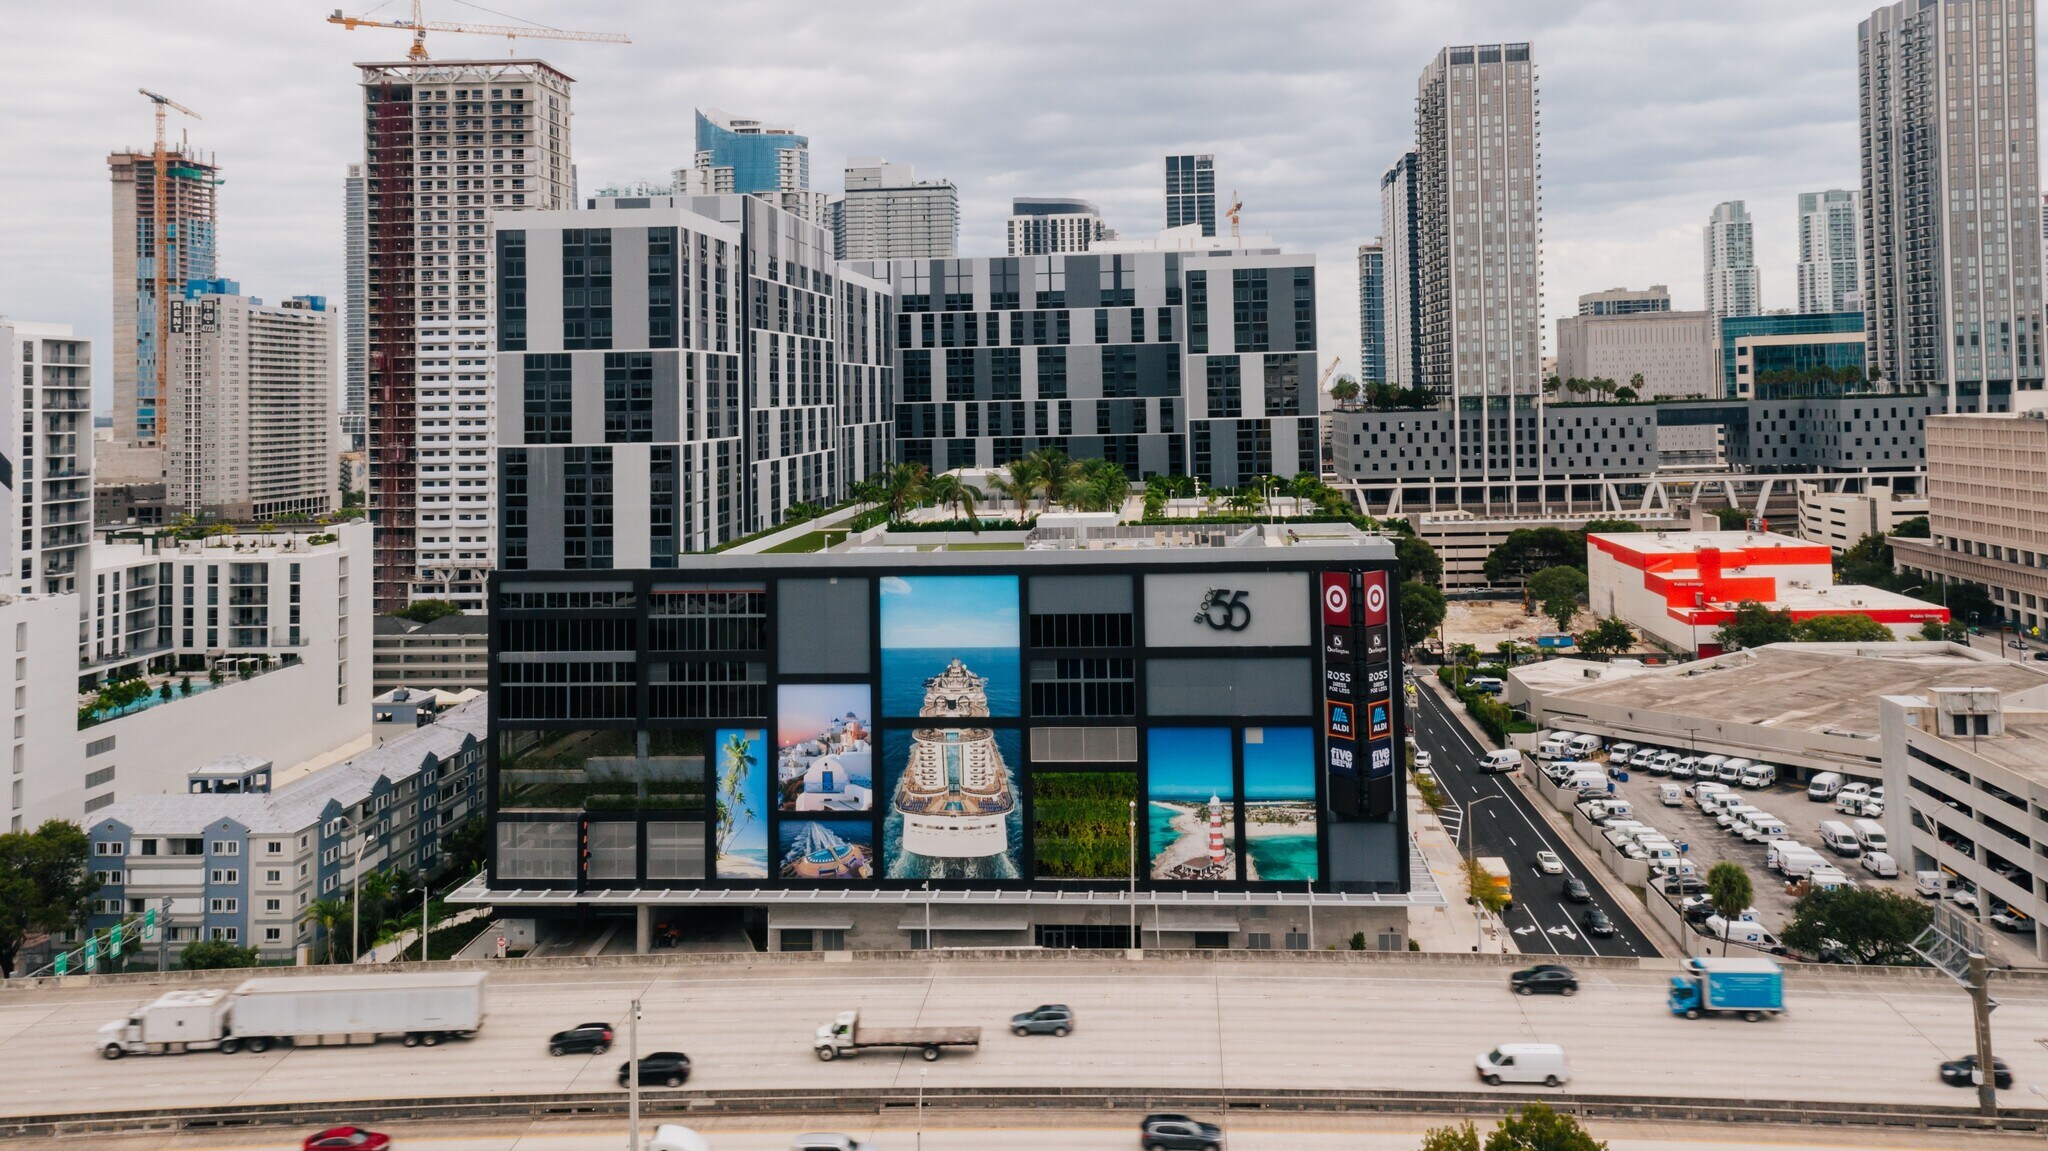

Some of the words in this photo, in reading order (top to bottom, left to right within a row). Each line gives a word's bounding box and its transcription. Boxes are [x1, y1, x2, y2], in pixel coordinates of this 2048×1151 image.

[173, 302, 182, 332] RENT
[1193, 586, 1217, 624] BLOCK
[1205, 588, 1251, 632] 55
[1326, 645, 1350, 655] Burlington
[1327, 670, 1351, 683] ROSS
[1368, 670, 1388, 682] ROSS
[1332, 723, 1350, 733] ALDI
[1373, 722, 1388, 733] ALDI
[1330, 747, 1353, 762] five
[1372, 747, 1390, 762] five
[1331, 758, 1353, 769] BELOW
[1372, 757, 1390, 769] BELOW
